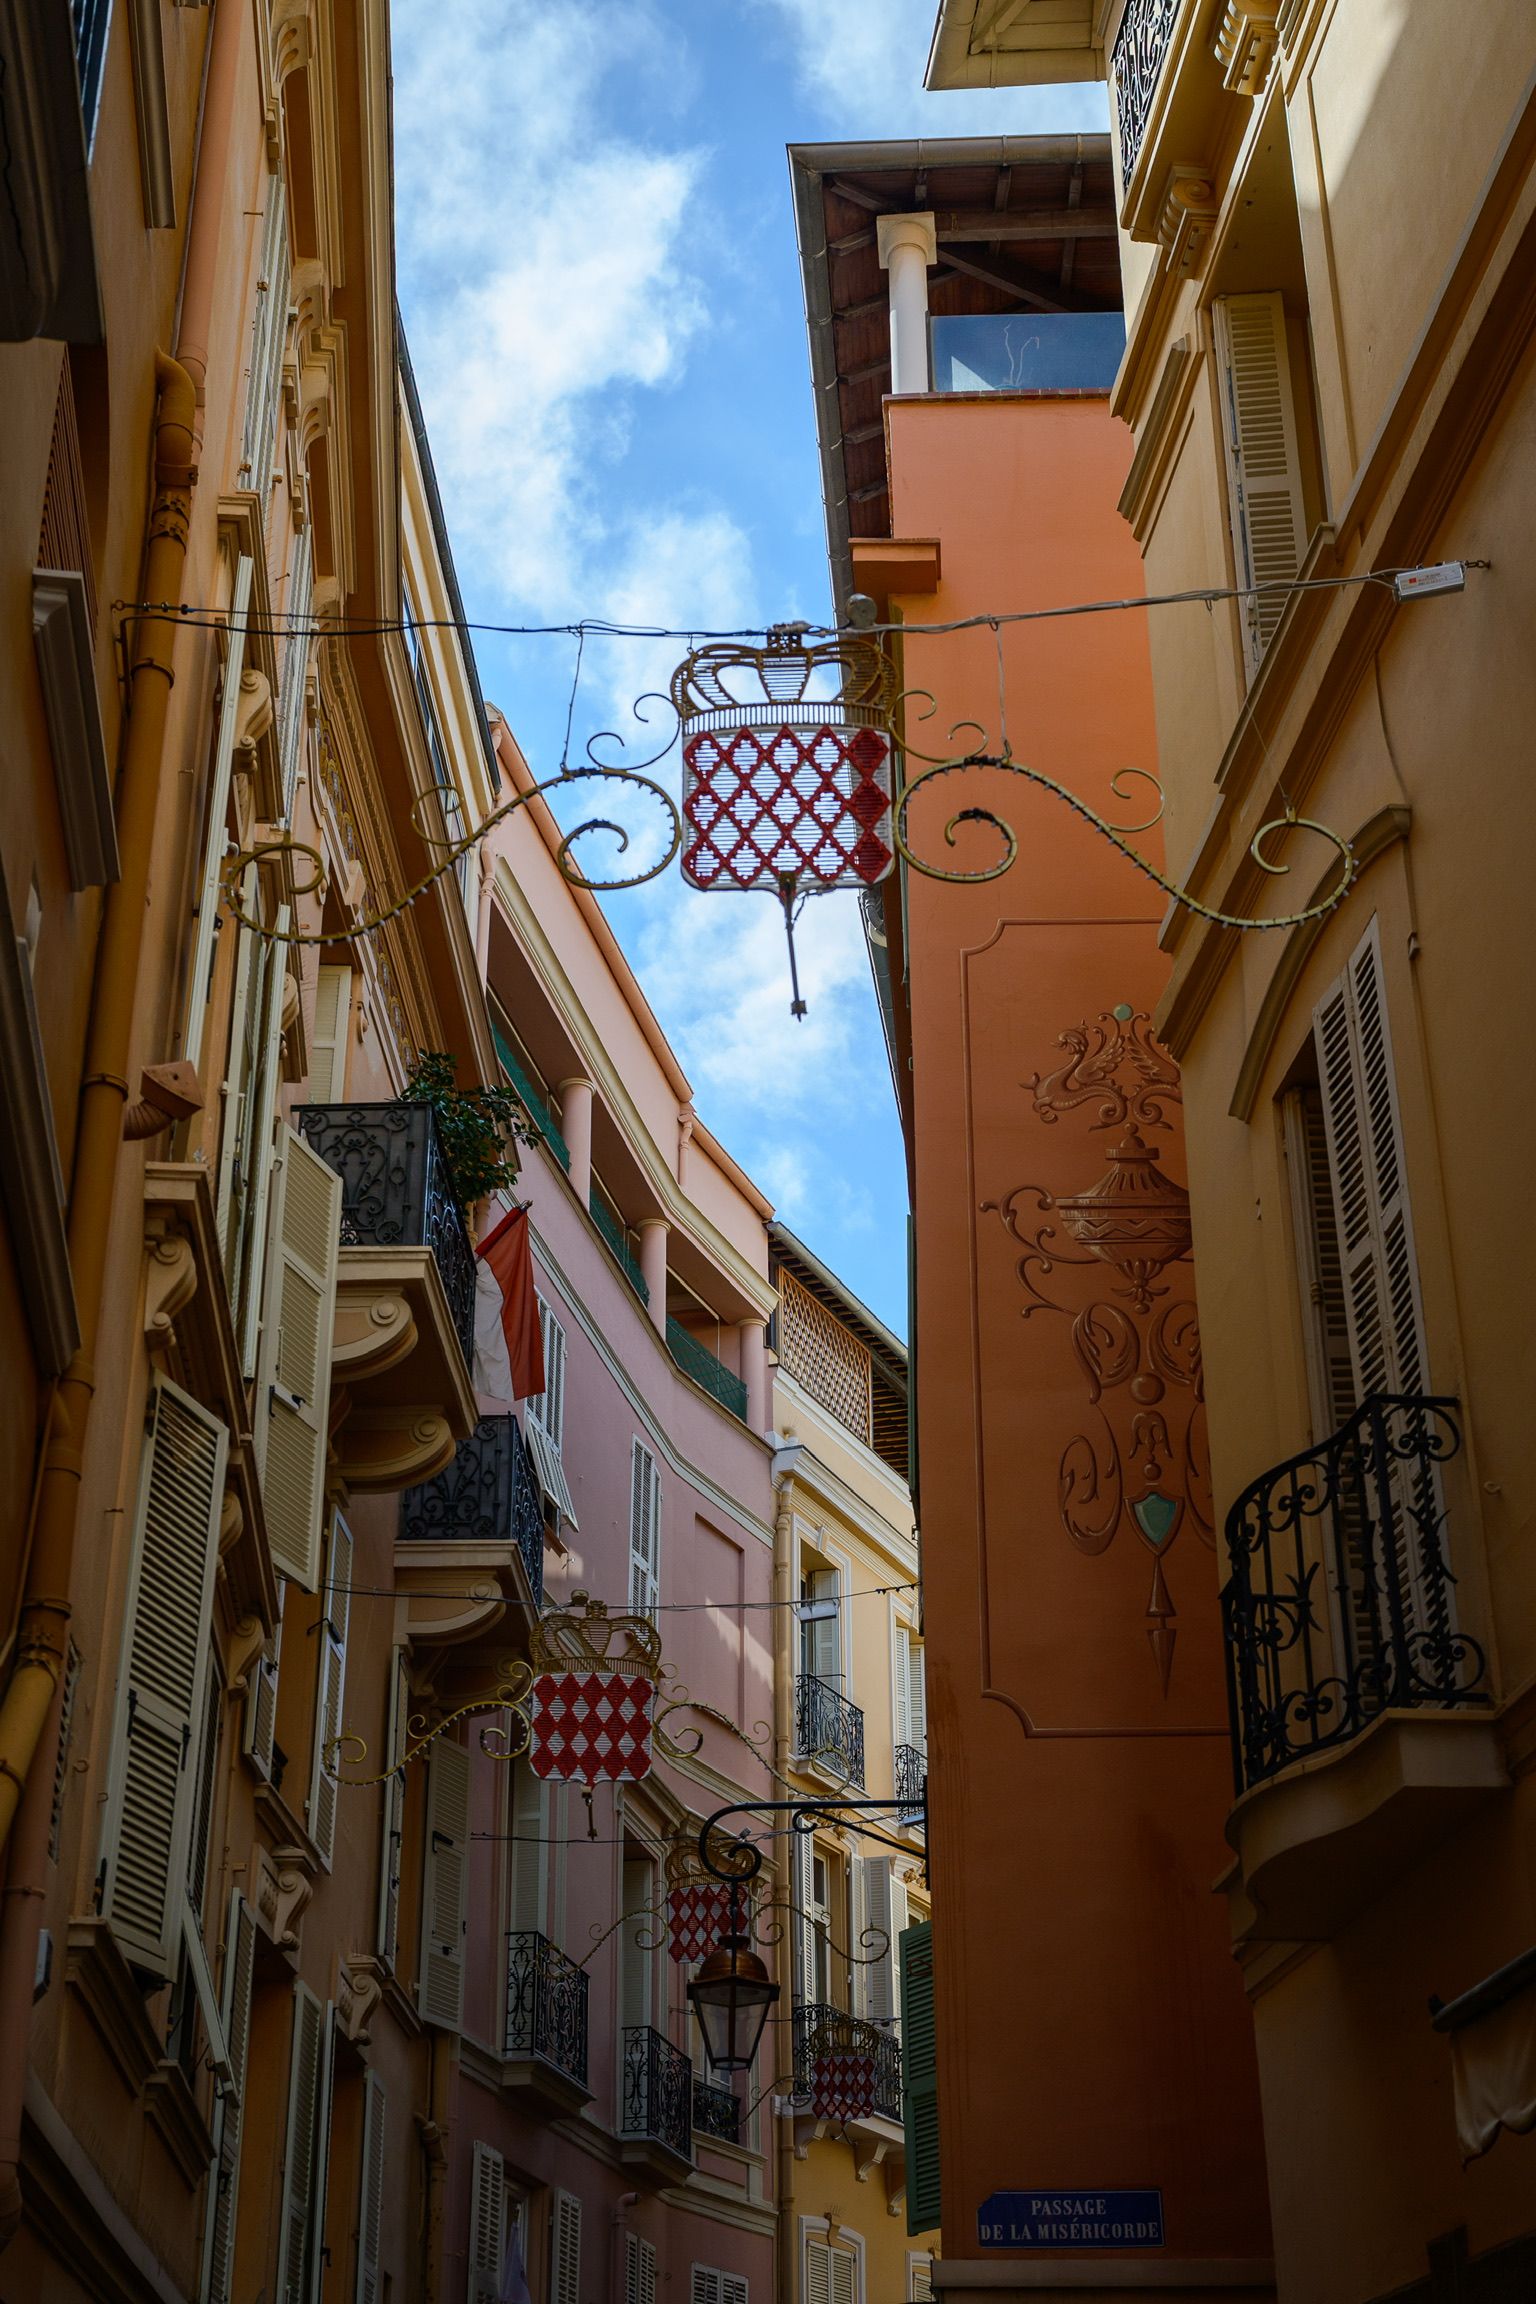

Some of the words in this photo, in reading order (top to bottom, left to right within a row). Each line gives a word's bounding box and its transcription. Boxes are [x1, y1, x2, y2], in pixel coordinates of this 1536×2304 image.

[1031, 2199, 1106, 2215] PASSAGE
[980, 2225, 1003, 2240] DE
[1011, 2224, 1032, 2240] LA
[1038, 2218, 1159, 2239] MISÉRICORDE
